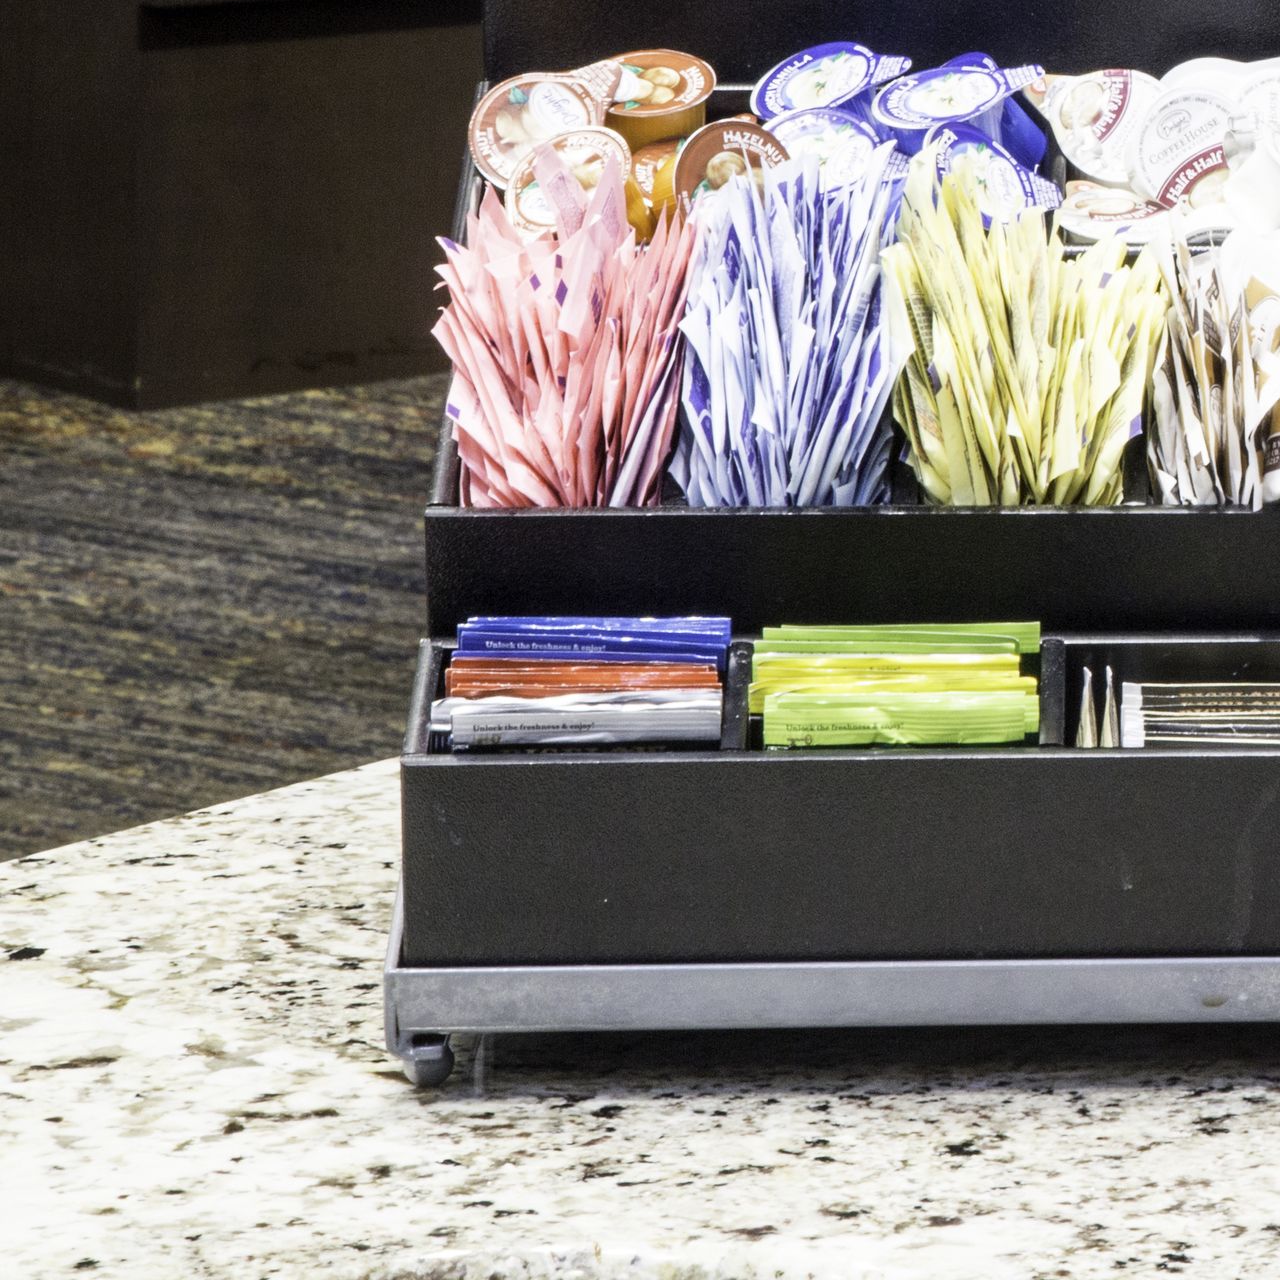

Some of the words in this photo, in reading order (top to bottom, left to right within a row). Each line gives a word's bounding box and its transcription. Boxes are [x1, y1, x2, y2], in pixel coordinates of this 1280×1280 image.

[485, 640, 516, 649] Unlock
[516, 640, 531, 650] the
[531, 641, 572, 651] freshness
[472, 724, 502, 732] Unlock
[504, 722, 519, 731] the
[519, 723, 560, 731] freshness
[785, 723, 815, 732] Unlock
[816, 723, 830, 731] the
